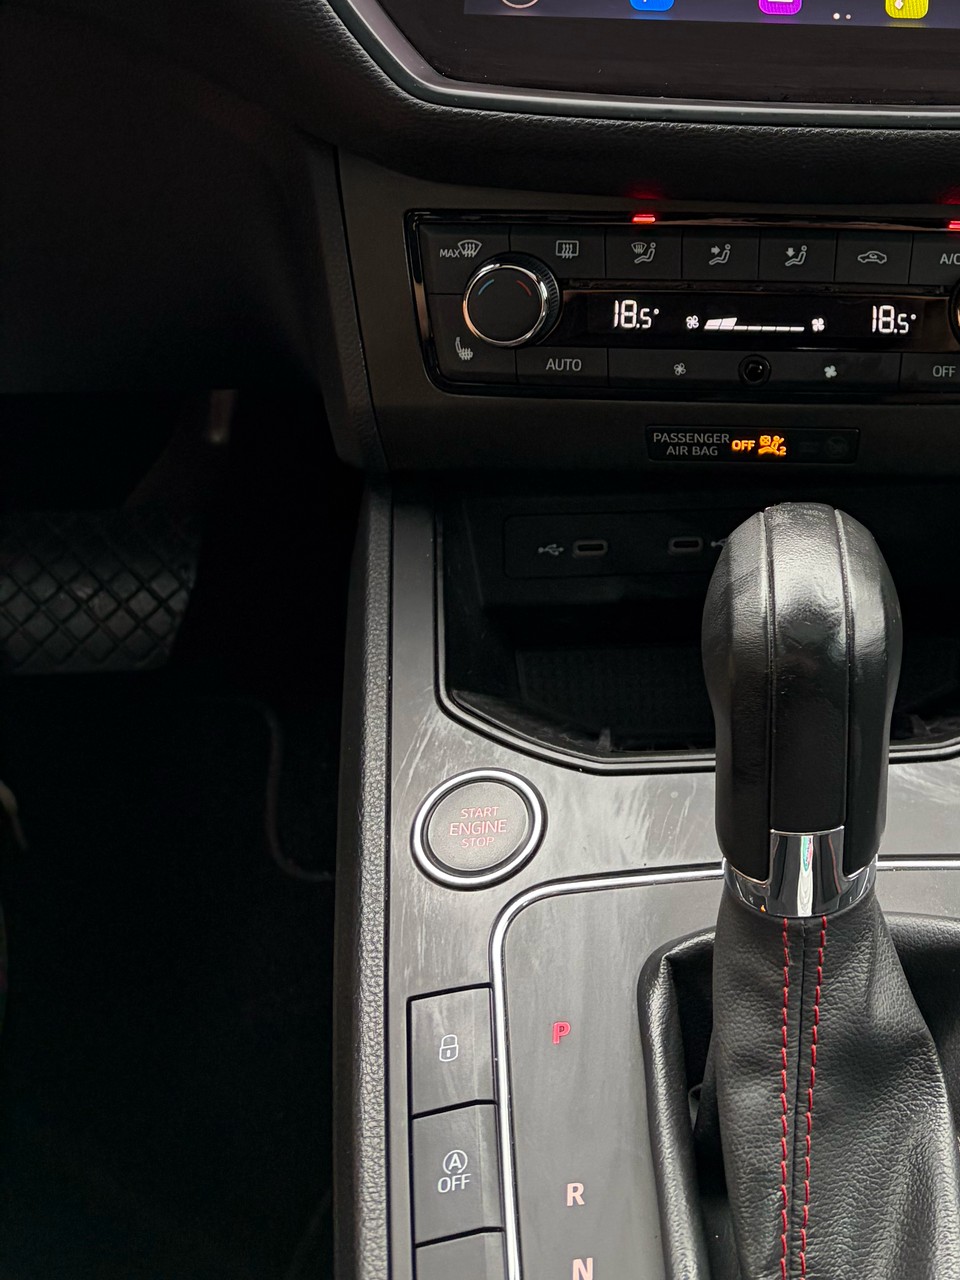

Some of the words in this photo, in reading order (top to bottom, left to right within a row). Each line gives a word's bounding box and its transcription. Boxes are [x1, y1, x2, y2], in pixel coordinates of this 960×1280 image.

[439, 246, 460, 259] MAX
[545, 358, 582, 372] AUTO
[932, 365, 956, 378] OFF
[653, 432, 730, 444] PASSENGER
[666, 445, 689, 456] AIR
[691, 445, 718, 456] BAG
[731, 439, 756, 453] OFF
[460, 806, 499, 819] START
[449, 819, 507, 836] ENGINE
[461, 836, 495, 848] STOP
[552, 1021, 571, 1045] P
[437, 1174, 471, 1193] OFF
[566, 1182, 585, 1208] R
[572, 1257, 594, 1280] N
